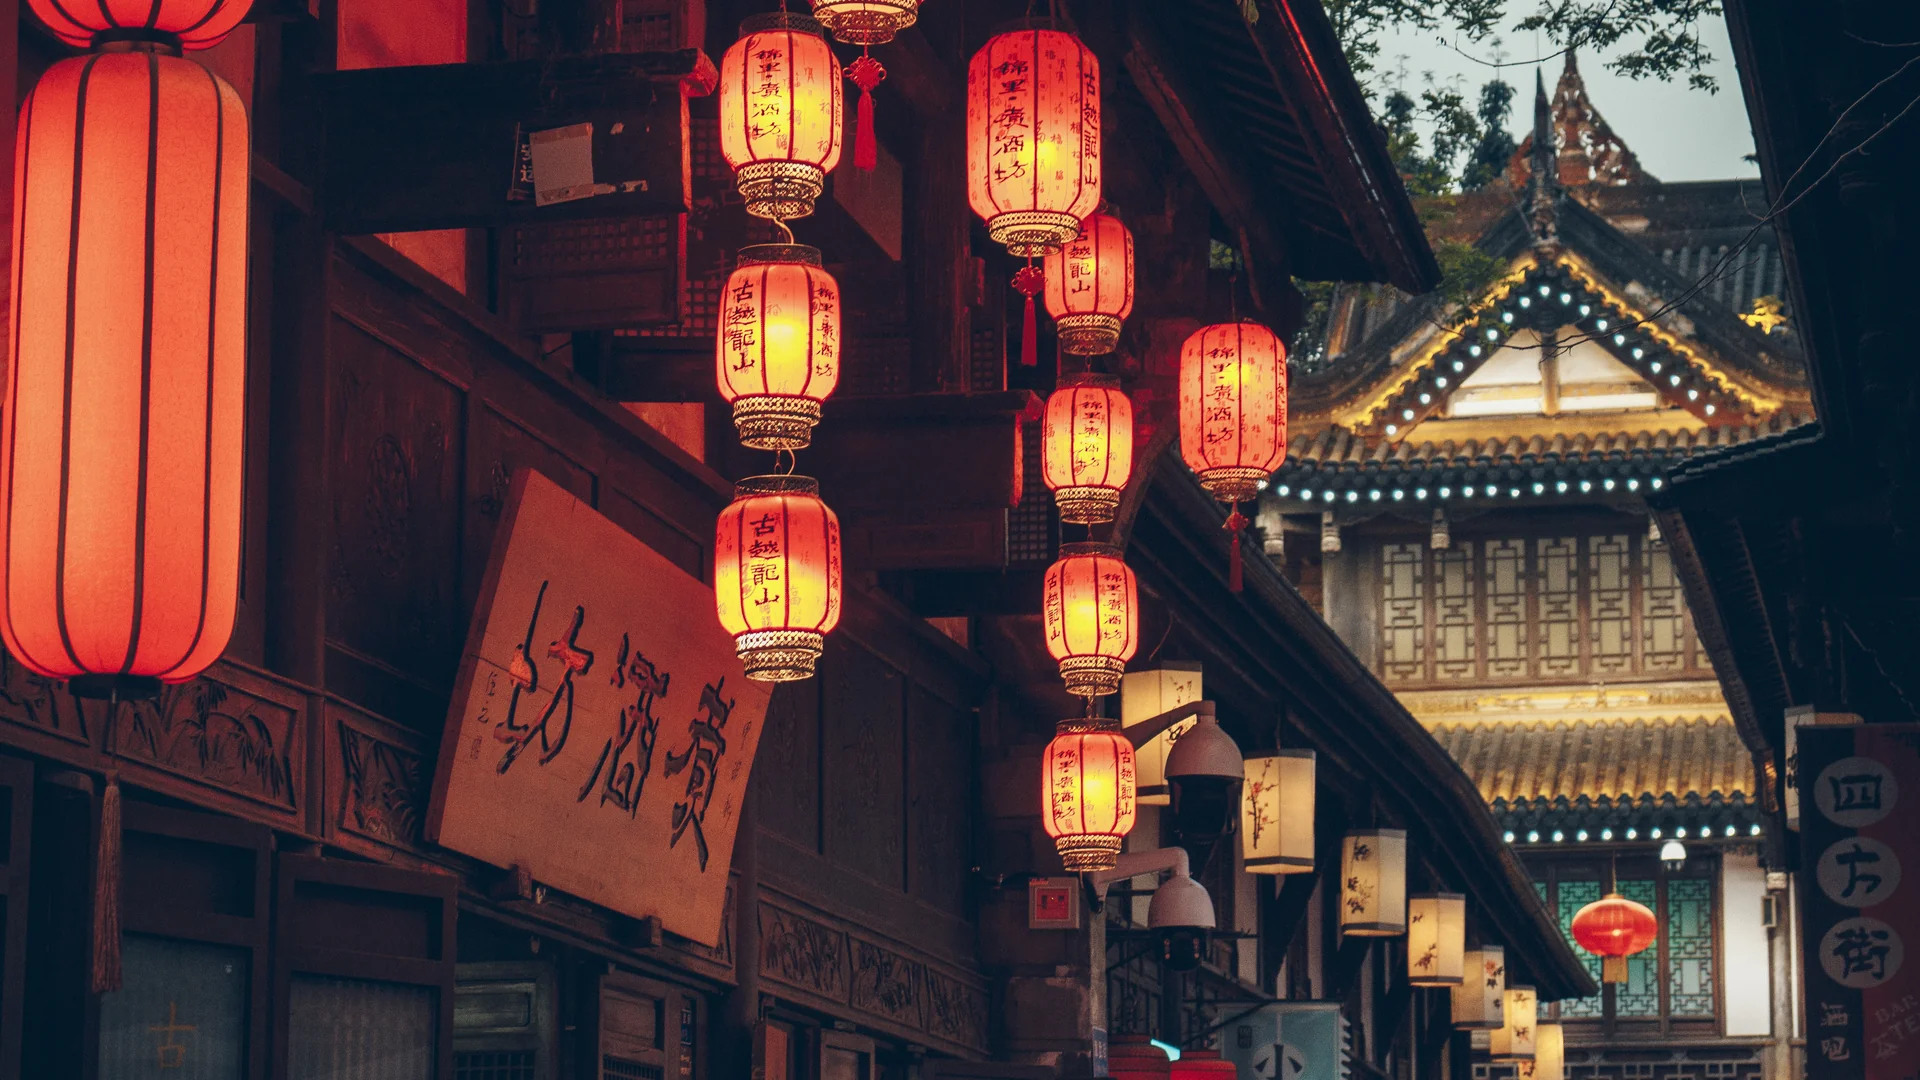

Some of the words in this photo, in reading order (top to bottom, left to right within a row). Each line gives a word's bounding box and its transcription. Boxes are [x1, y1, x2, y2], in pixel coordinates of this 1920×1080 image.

[729, 280, 757, 372] 古越龍山
[748, 513, 781, 606] 古越龍山
[1829, 771, 1890, 982] 四方街
[148, 1000, 197, 1070] 古
[1820, 1001, 1850, 1062] 酒吧
